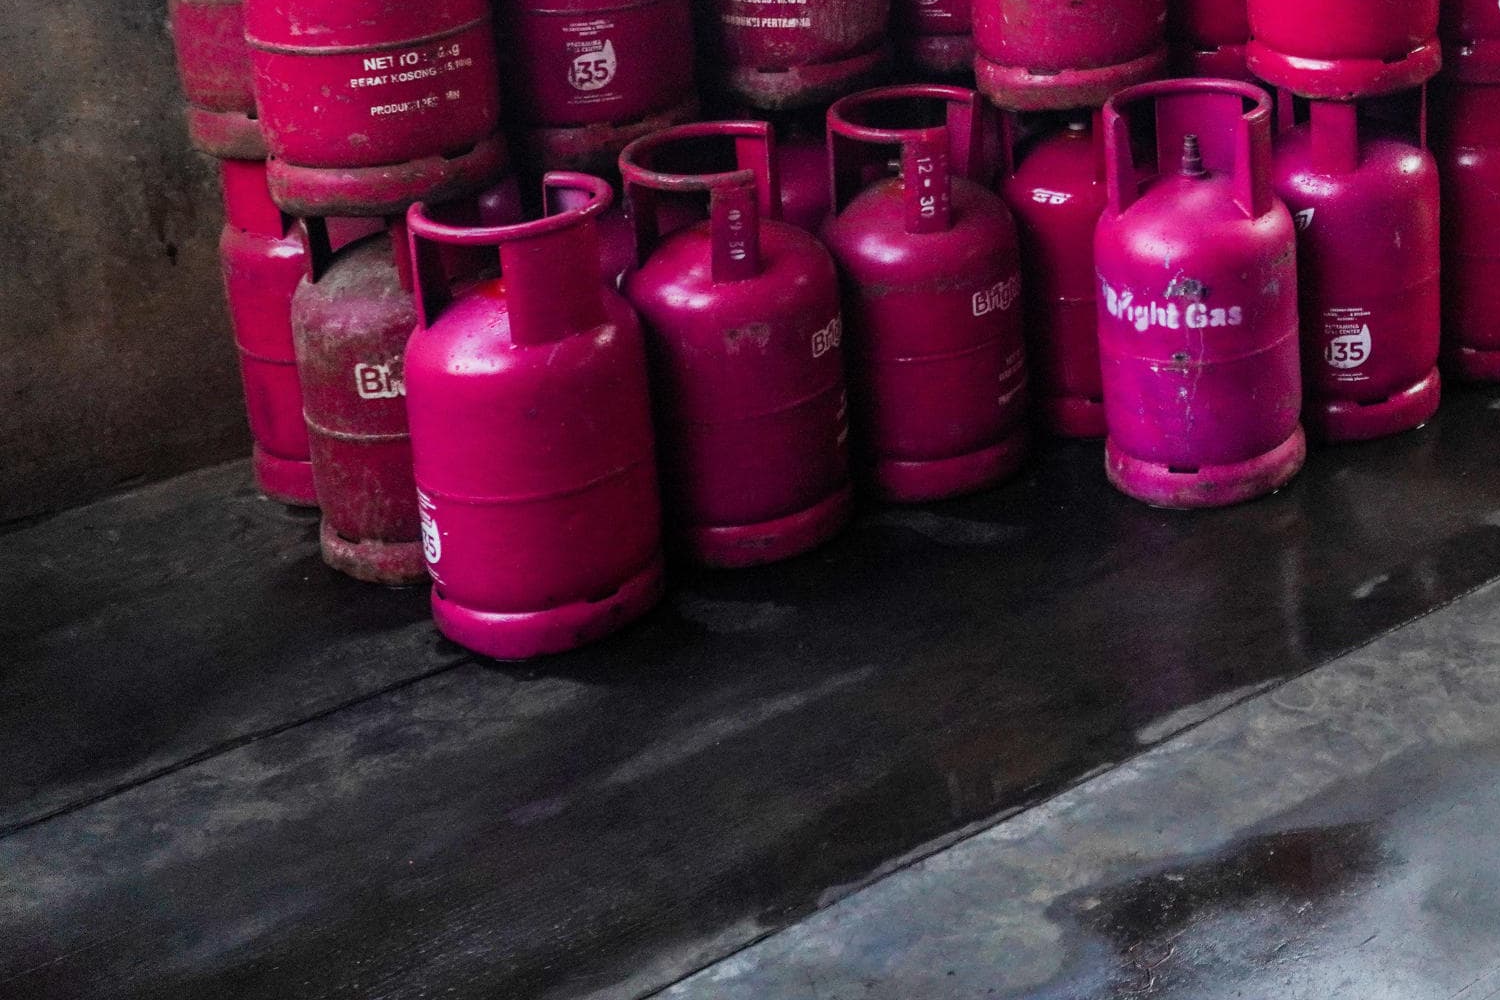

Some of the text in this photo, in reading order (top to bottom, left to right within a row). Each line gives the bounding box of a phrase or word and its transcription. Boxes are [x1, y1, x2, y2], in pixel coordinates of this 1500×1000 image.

[349, 75, 389, 89] BERAT
[390, 67, 437, 84] KOSONG
[570, 59, 609, 83] 135
[1185, 302, 1243, 328] Gas
[1327, 341, 1365, 362] 135
